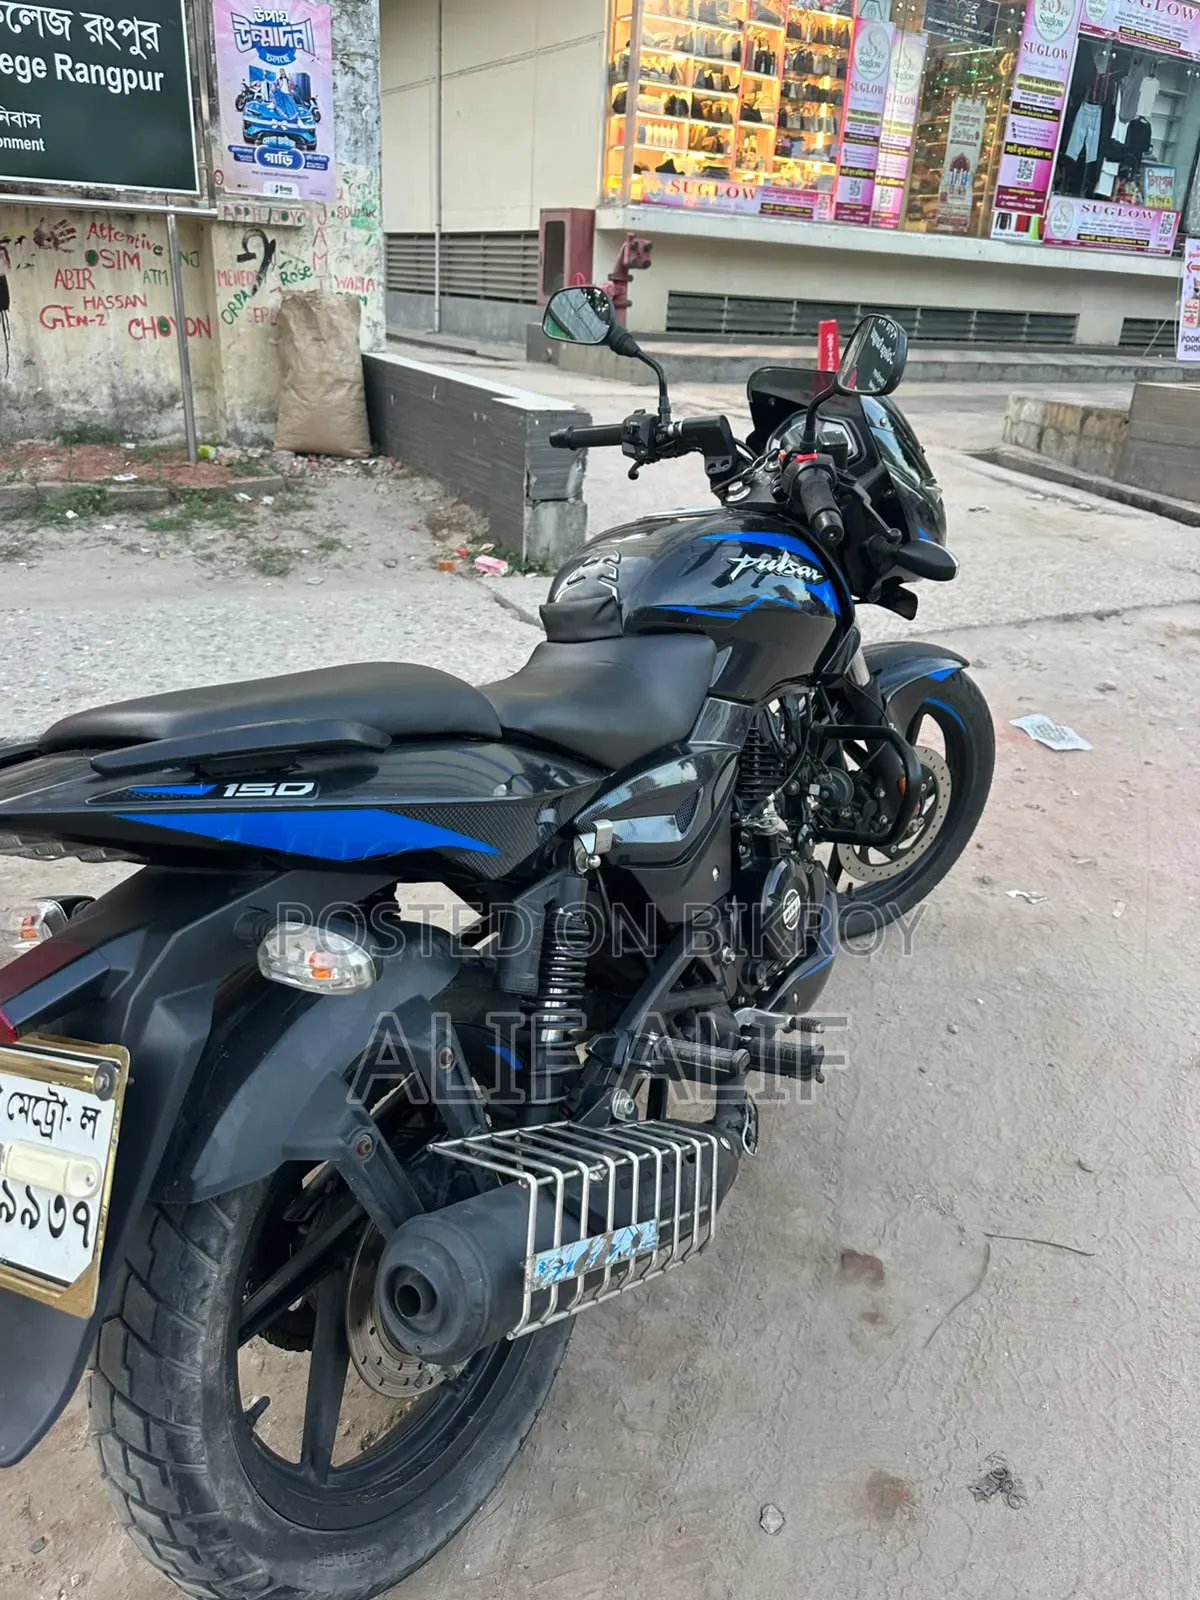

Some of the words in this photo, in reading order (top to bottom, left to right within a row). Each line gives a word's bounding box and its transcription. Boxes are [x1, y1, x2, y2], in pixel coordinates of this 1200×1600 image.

[1128, 0, 1199, 20] GLOW
[0, 3, 73, 42] লেজ
[79, 12, 162, 60] রংপুর
[1023, 41, 1069, 60] SUGLOW
[54, 52, 164, 95] Rangpur
[264, 151, 293, 167] গাড়ি
[671, 179, 757, 200] SUGLOW
[1081, 203, 1153, 219] SUGLOW
[54, 267, 96, 290] ABIR
[83, 292, 148, 310] HASSAN
[222, 782, 315, 798] 150
